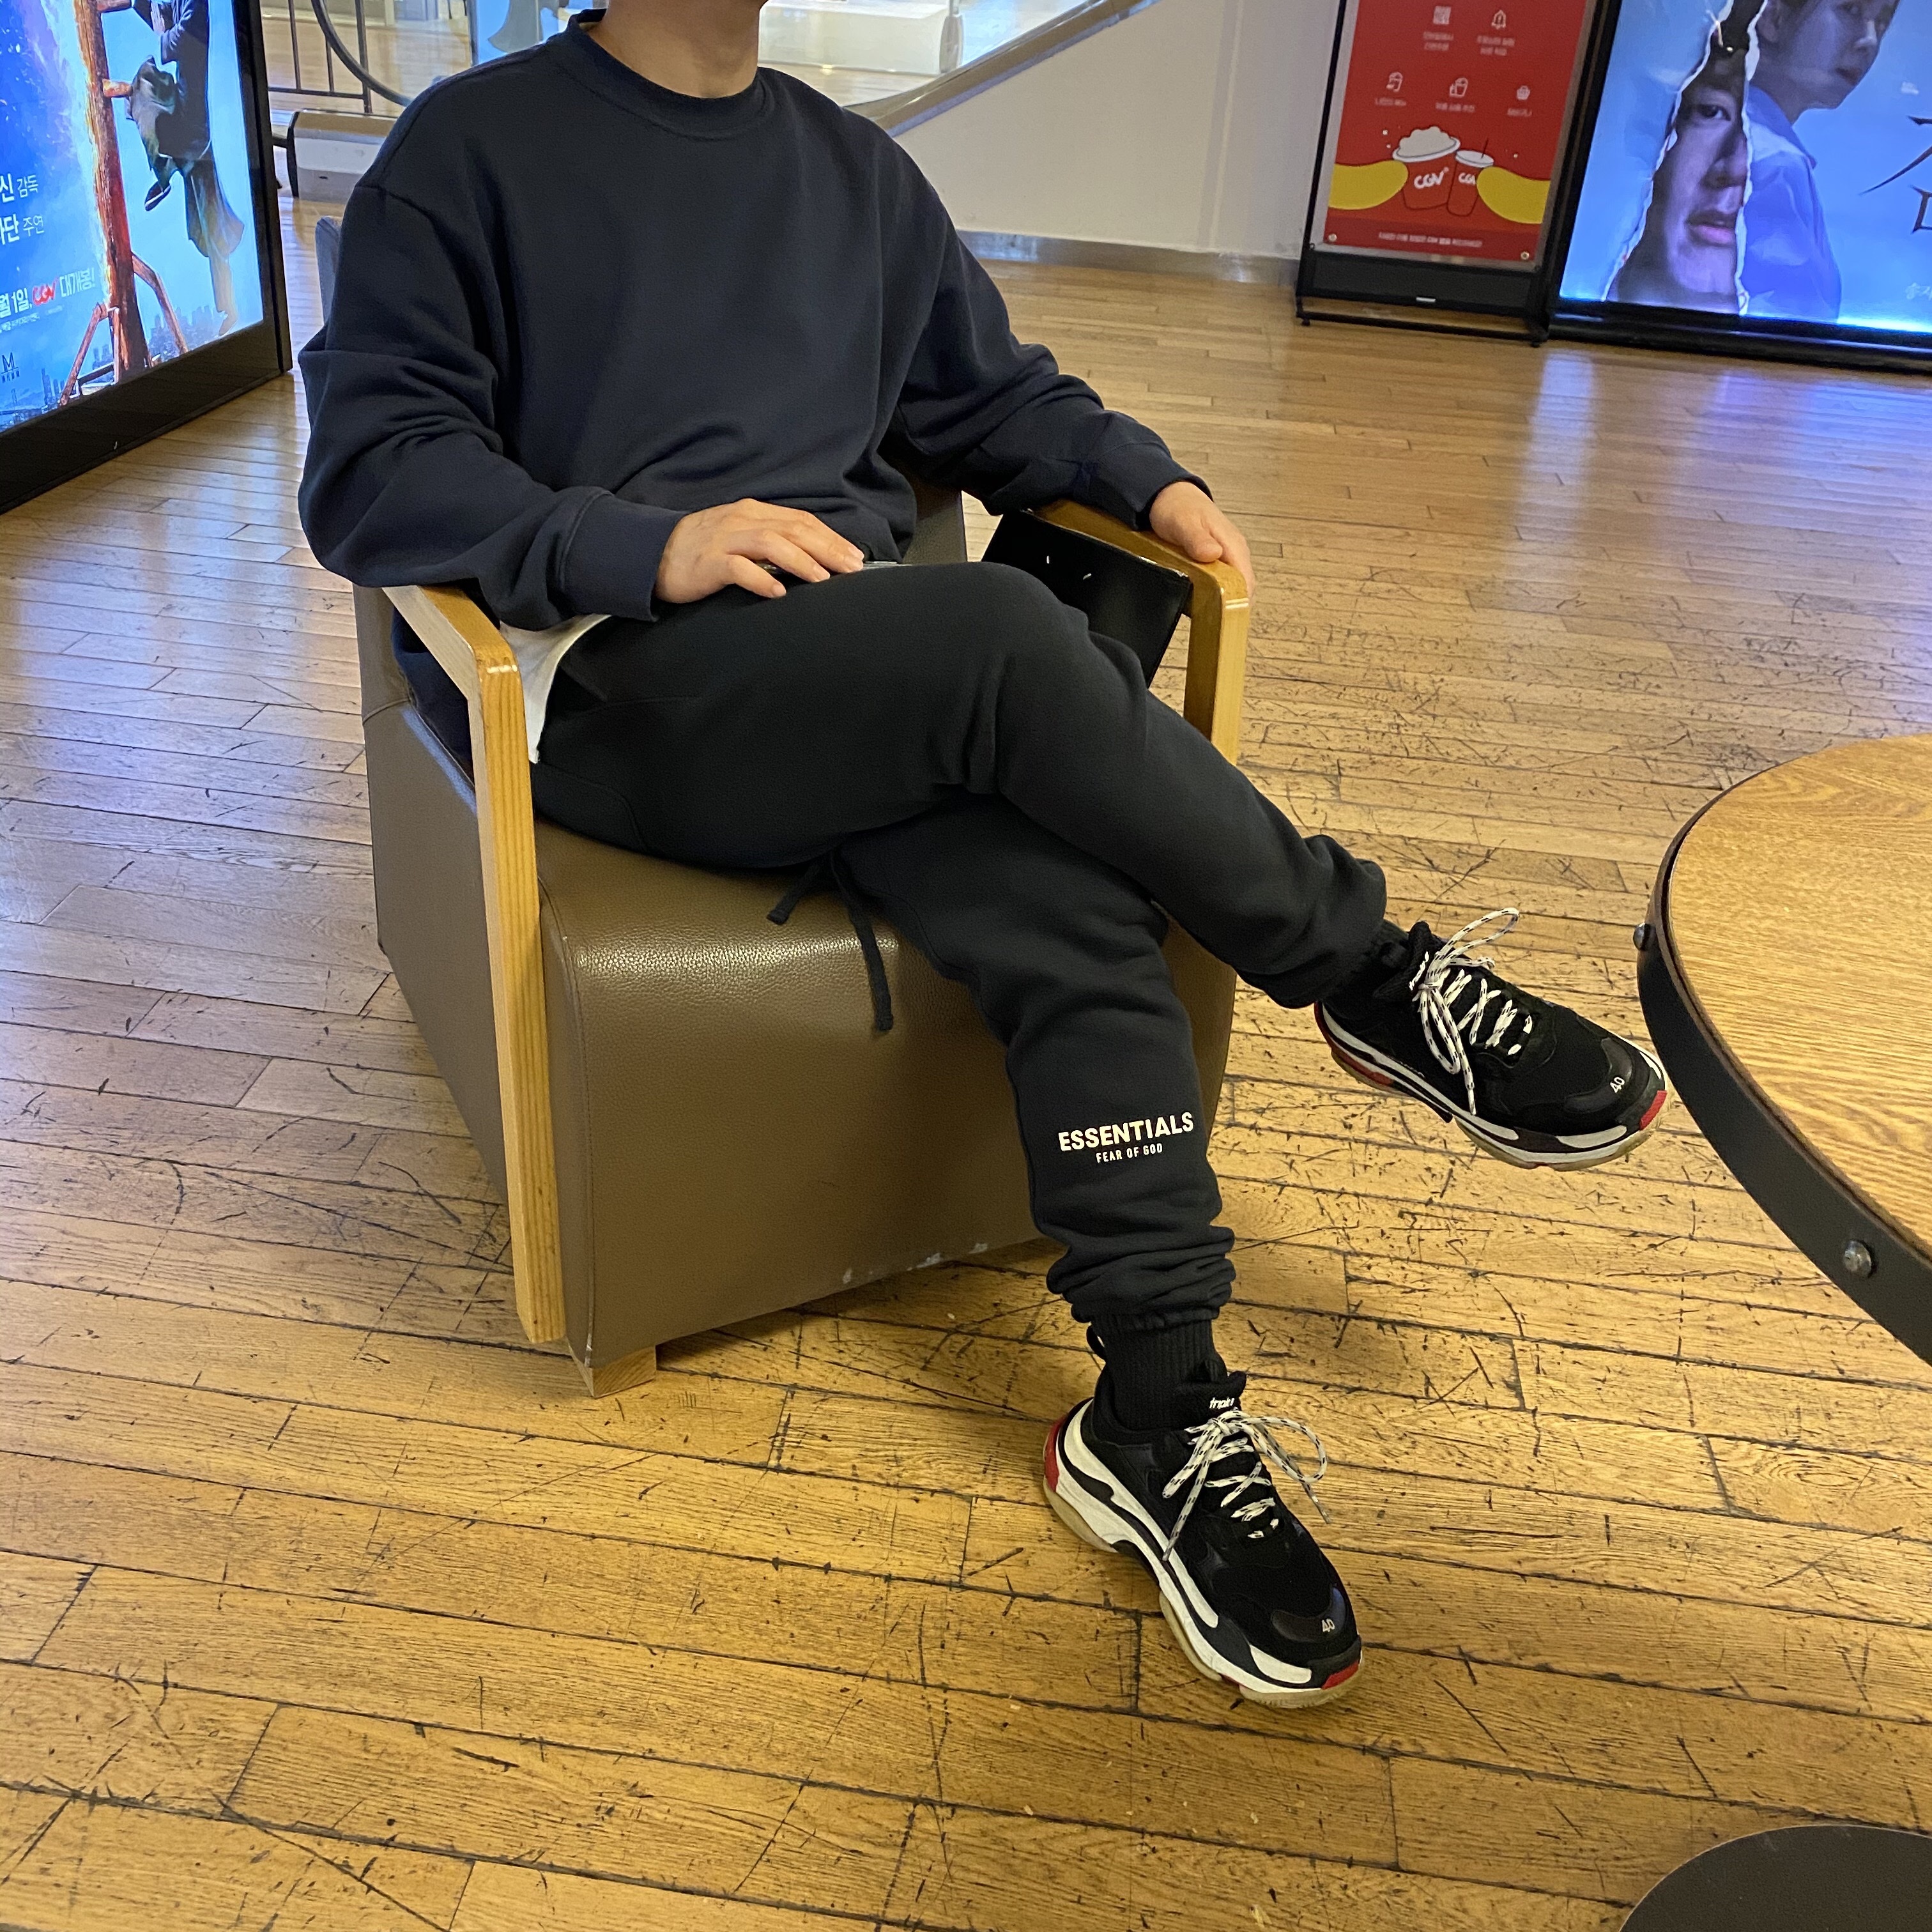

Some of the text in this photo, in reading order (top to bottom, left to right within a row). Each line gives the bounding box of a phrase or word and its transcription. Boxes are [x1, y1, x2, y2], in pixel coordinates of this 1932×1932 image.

[17, 174, 39, 198] 감독
[1414, 168, 1445, 188] CGV
[23, 215, 45, 237] 주연
[59, 267, 95, 297] 대개봉!
[1610, 1077, 1625, 1093] 40
[1058, 1112, 1194, 1151] ESSENTIALS
[1096, 1143, 1163, 1163] FEAR OF GOD
[1321, 1618, 1335, 1632] 40
